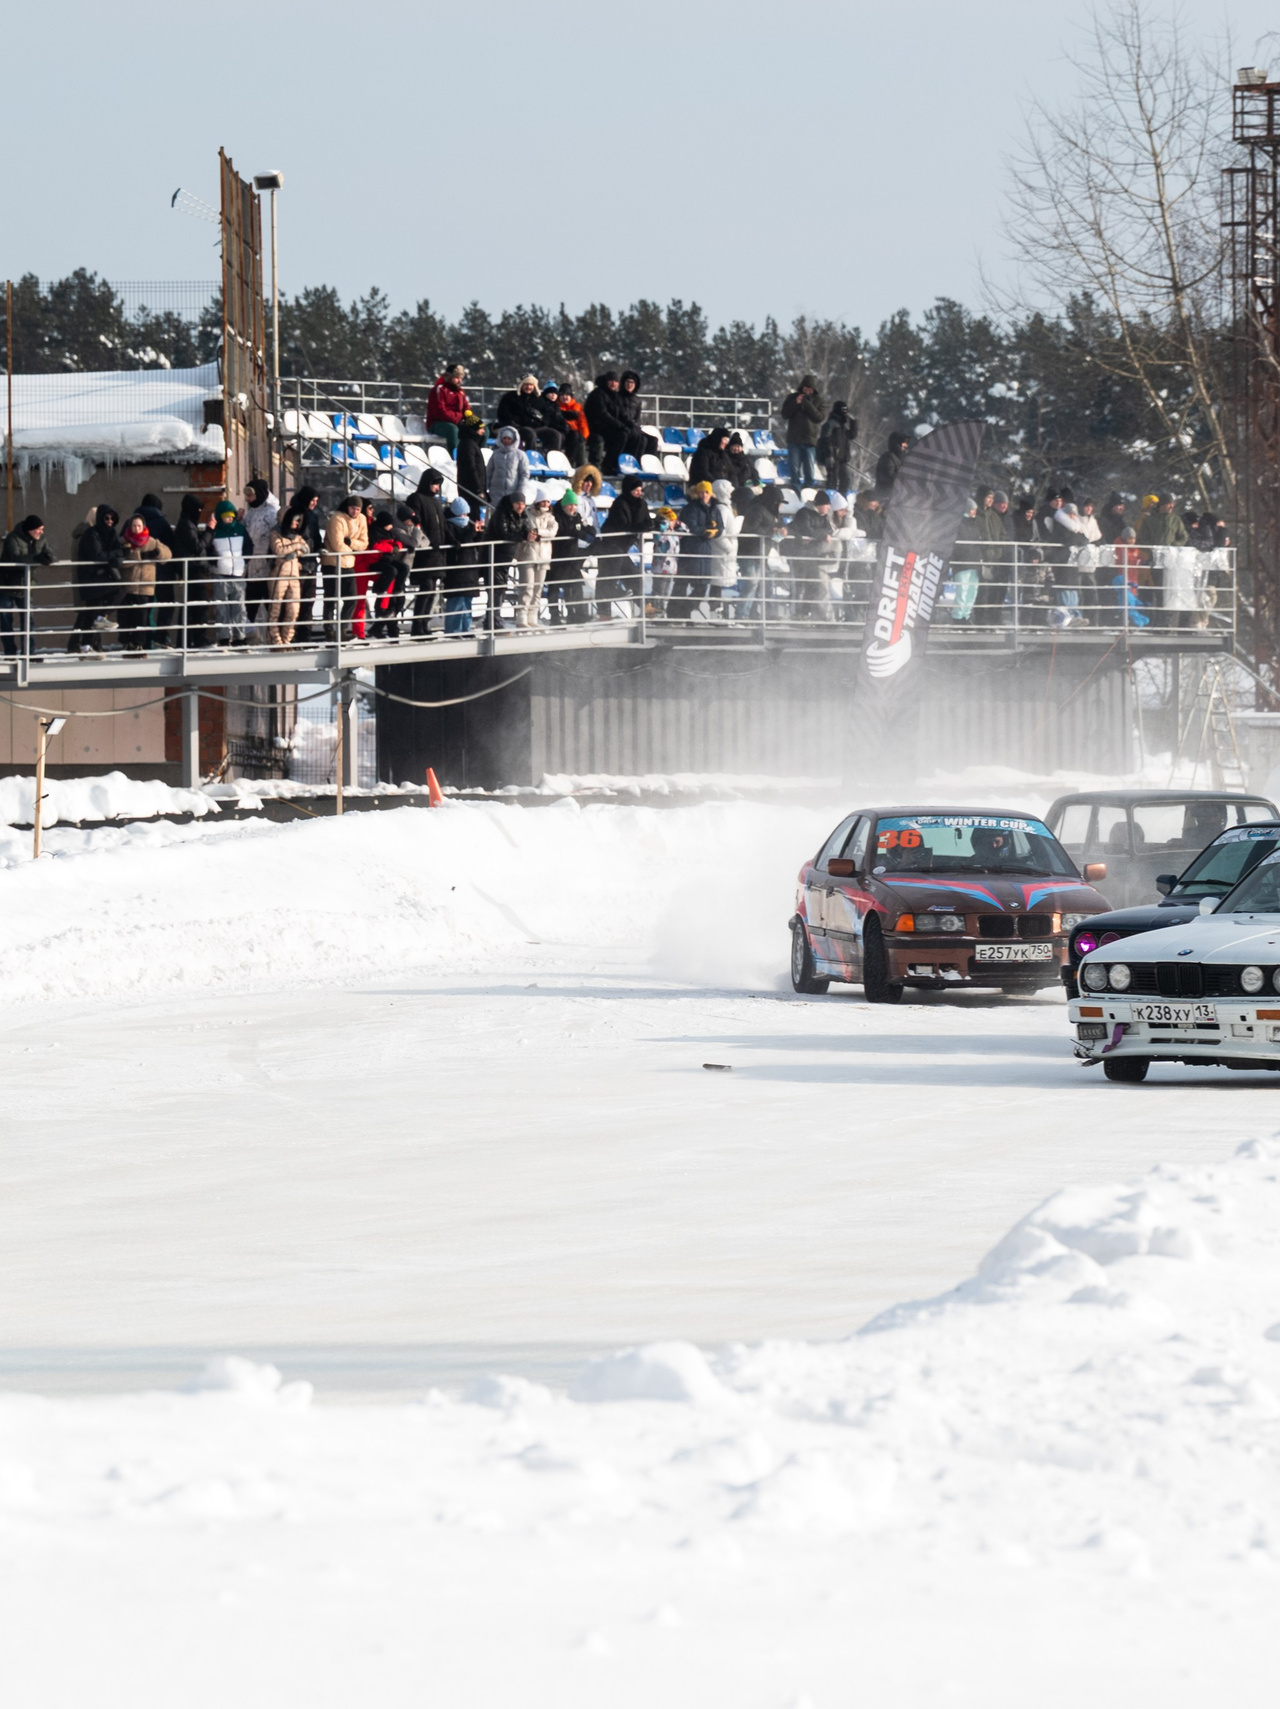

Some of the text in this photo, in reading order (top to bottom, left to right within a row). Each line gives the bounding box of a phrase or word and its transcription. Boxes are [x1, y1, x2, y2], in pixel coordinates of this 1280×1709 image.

[874, 546, 905, 642] DRIFT
[899, 561, 912, 598] EXPO
[903, 554, 928, 629] TRACK
[917, 551, 944, 622] MODE
[876, 829, 921, 849] 36
[944, 817, 997, 828] WINTER
[1000, 818, 1027, 830] CUP
[1195, 1004, 1210, 1017] 13
